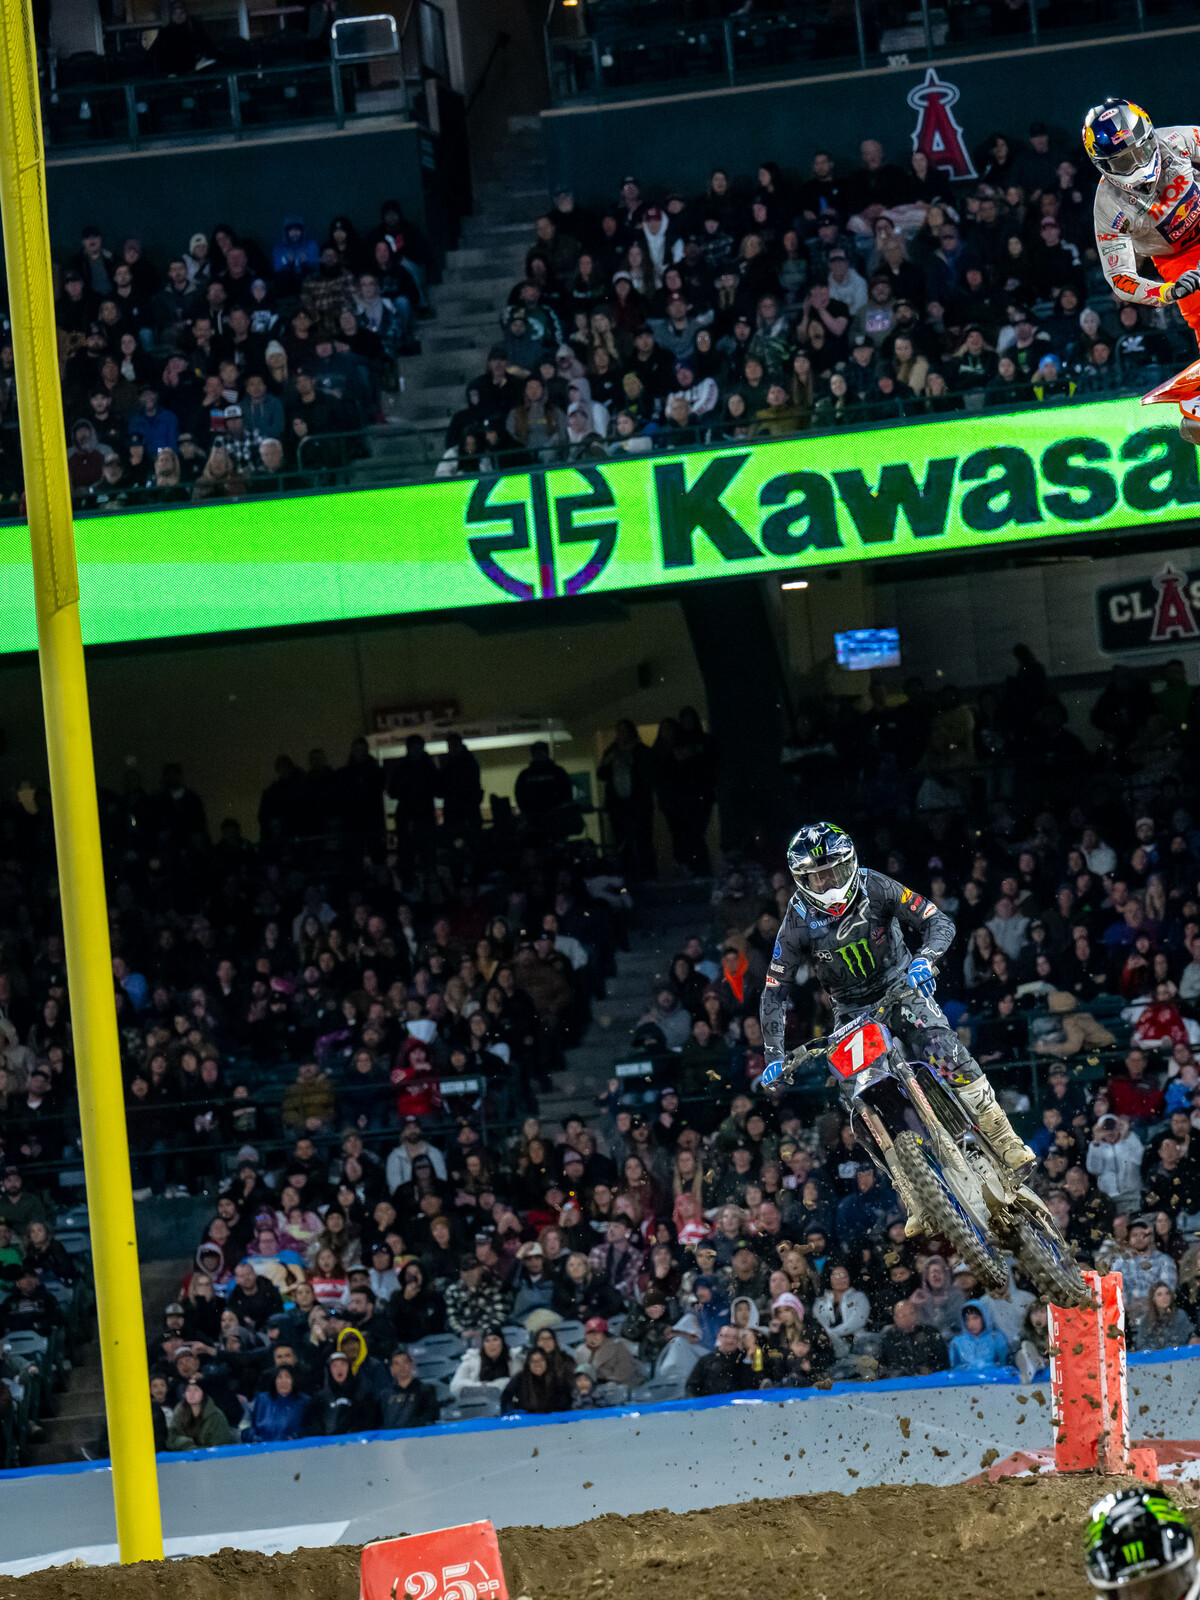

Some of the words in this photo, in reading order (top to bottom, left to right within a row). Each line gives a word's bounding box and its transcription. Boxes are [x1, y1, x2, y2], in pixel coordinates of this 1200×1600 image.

[1147, 174, 1190, 221] THOR
[1169, 215, 1191, 242] Red
[1111, 273, 1141, 296] KTM
[843, 1030, 865, 1072] 1
